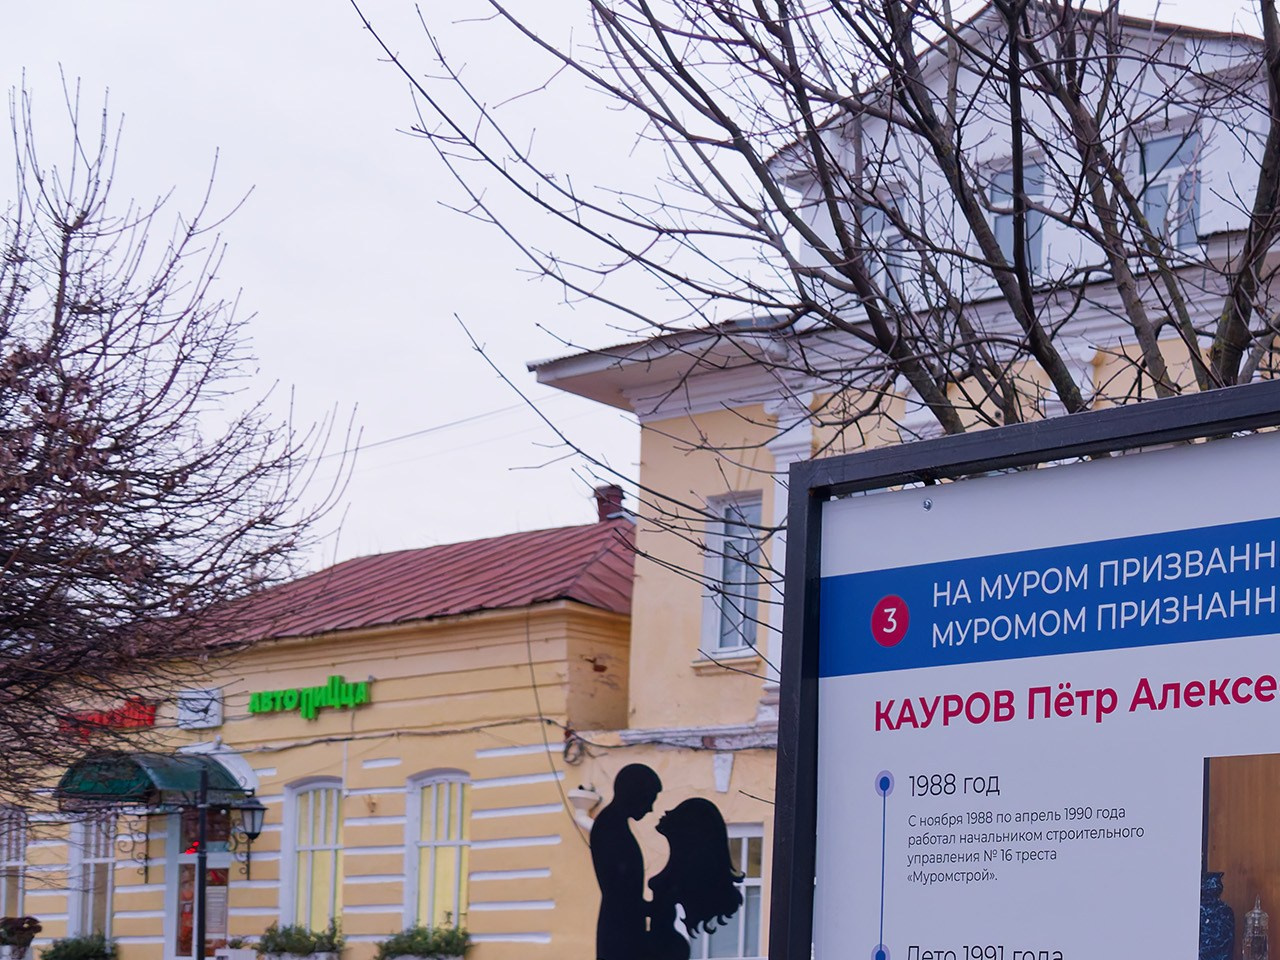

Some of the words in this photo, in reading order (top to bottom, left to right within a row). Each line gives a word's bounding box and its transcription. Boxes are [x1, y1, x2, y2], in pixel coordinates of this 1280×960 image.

[934, 579, 971, 607] НА
[981, 566, 1087, 601] МУРОМ
[883, 608, 896, 633] 3
[933, 607, 1085, 647] МУРОМОМ
[876, 690, 1015, 731] КАУРОВ
[1028, 682, 1117, 723] Пётр
[908, 773, 957, 797] 1988
[963, 775, 1001, 797] год
[908, 814, 917, 828] С
[919, 812, 963, 828] ноября
[966, 810, 993, 825] 1988
[996, 812, 1012, 824] по
[1014, 810, 1062, 825] апрель
[1064, 806, 1093, 821] 1990
[1096, 807, 1126, 821] года
[908, 831, 956, 849] работал
[959, 831, 1043, 844] начальником
[1045, 827, 1145, 844] строительного
[906, 852, 980, 868] управления
[983, 849, 998, 862] №
[1000, 848, 1013, 862] 16
[1015, 849, 1057, 864] треста
[907, 868, 998, 886] «Муромстрой».
